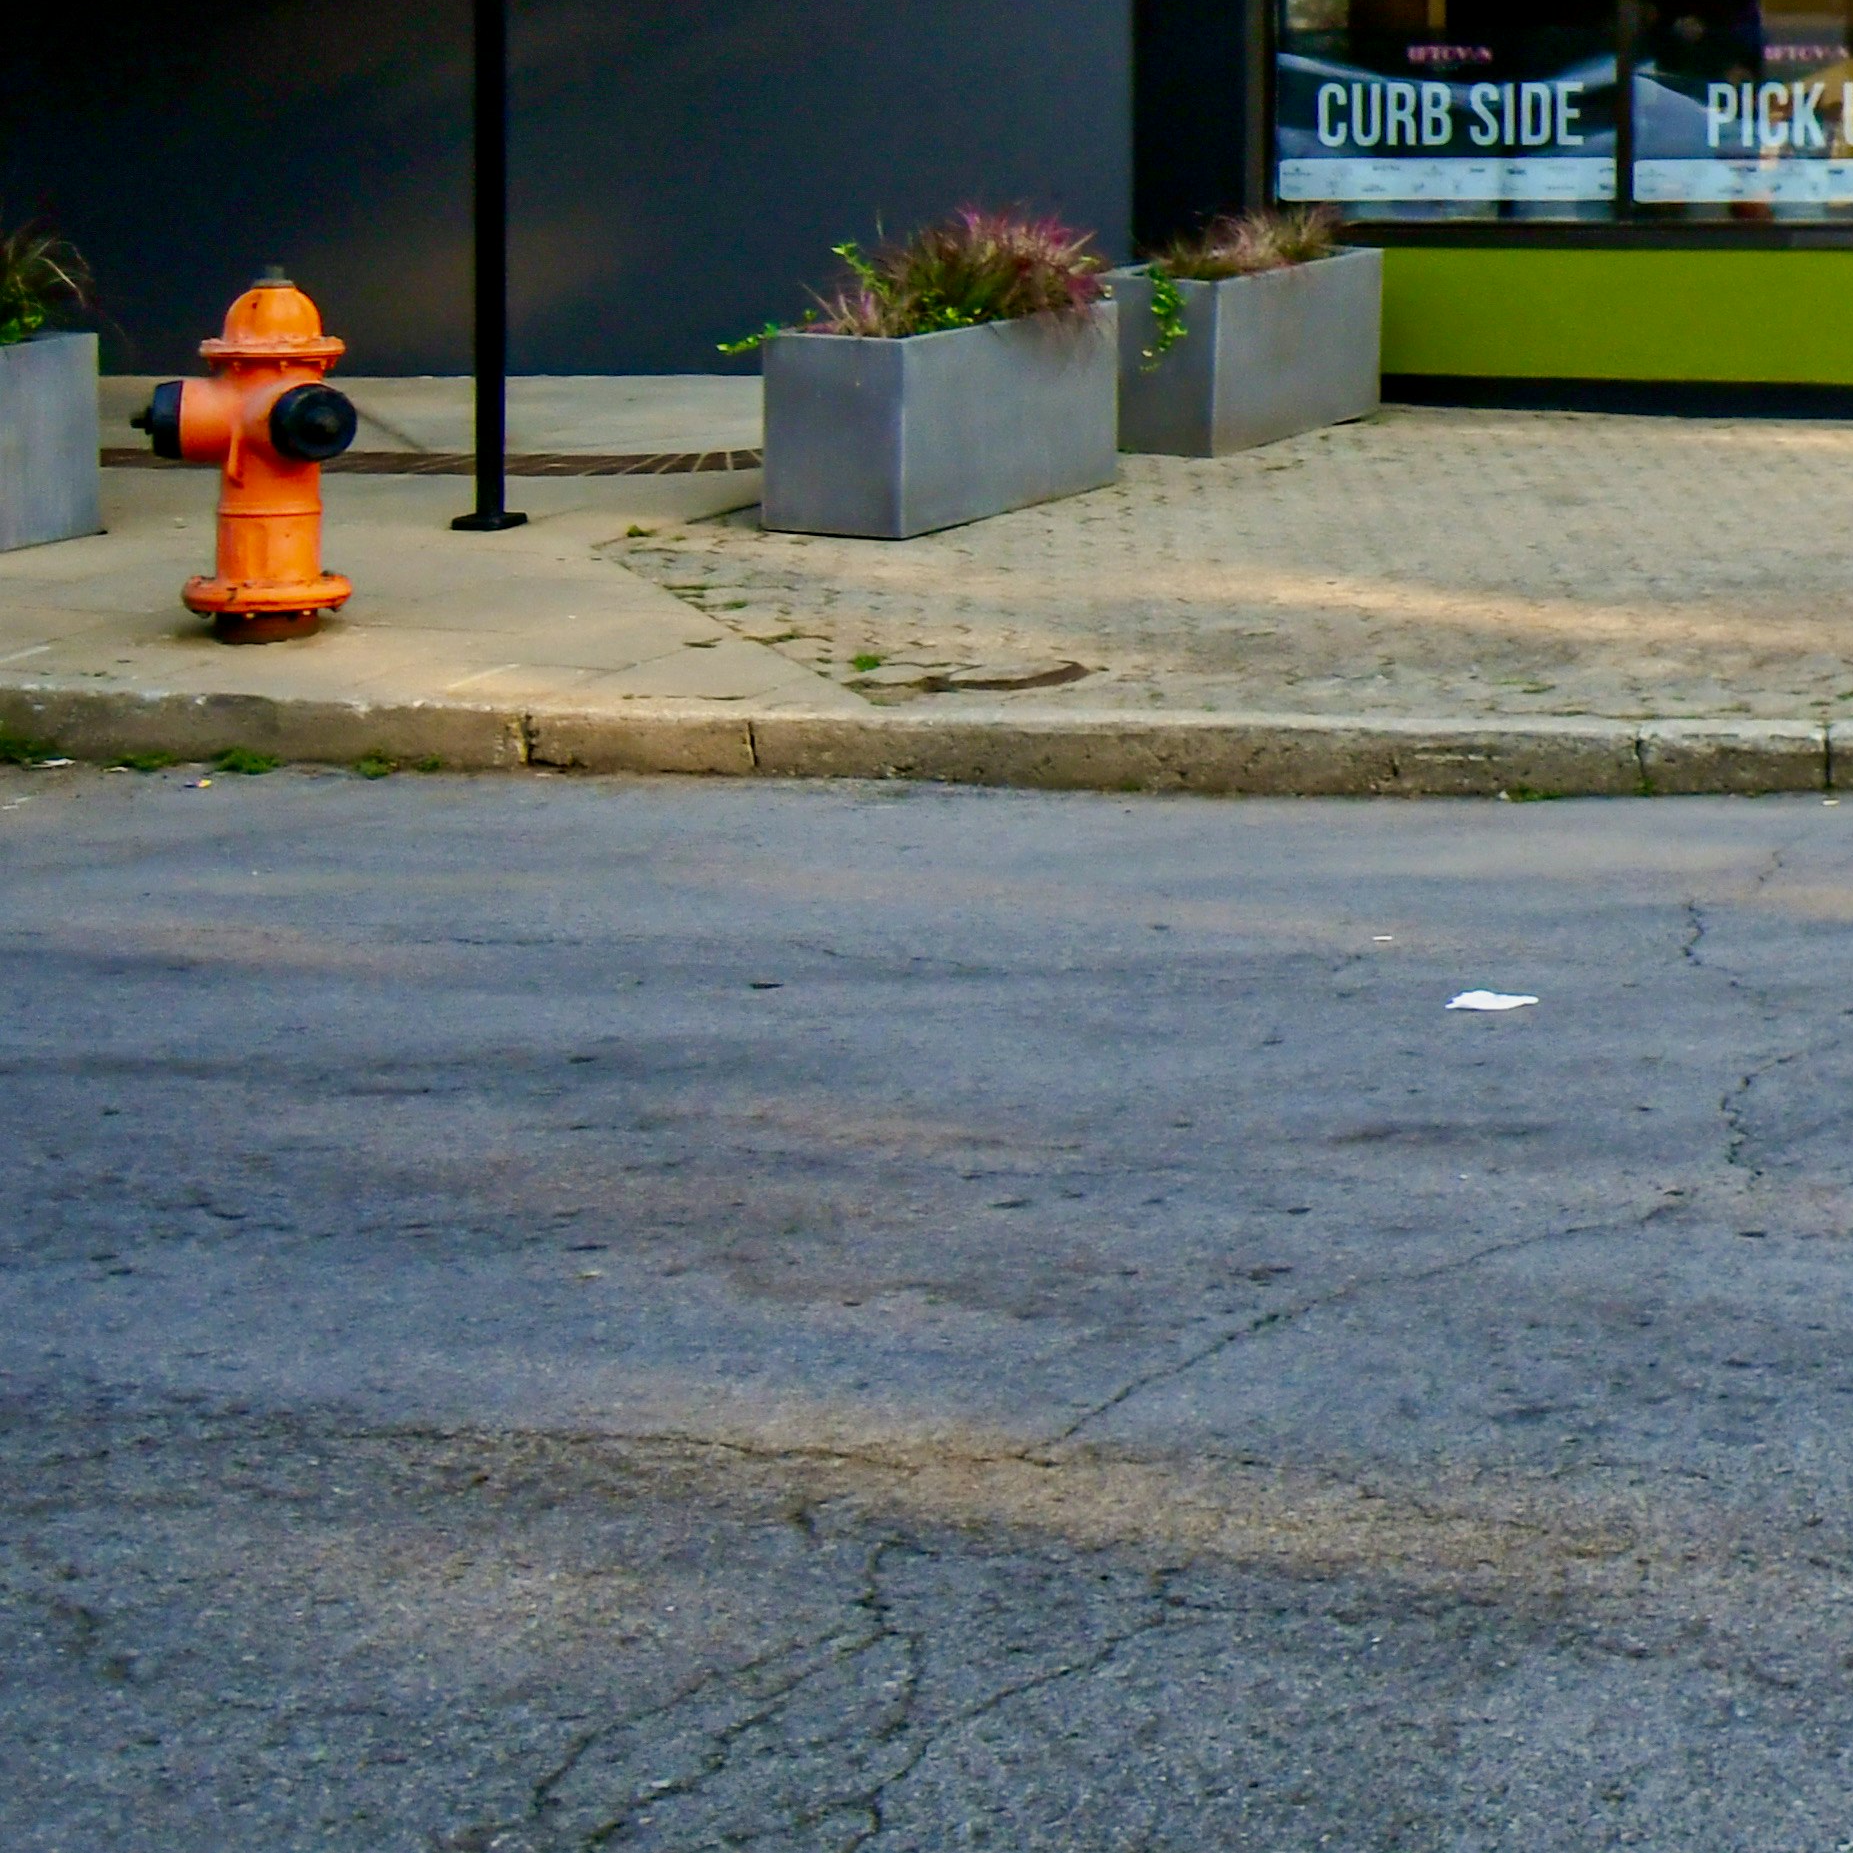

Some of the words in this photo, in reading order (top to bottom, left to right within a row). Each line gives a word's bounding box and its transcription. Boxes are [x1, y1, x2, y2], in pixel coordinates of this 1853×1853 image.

[1317, 81, 1453, 148] CURB
[1469, 81, 1585, 147] SIDE
[1706, 81, 1827, 148] PICK
